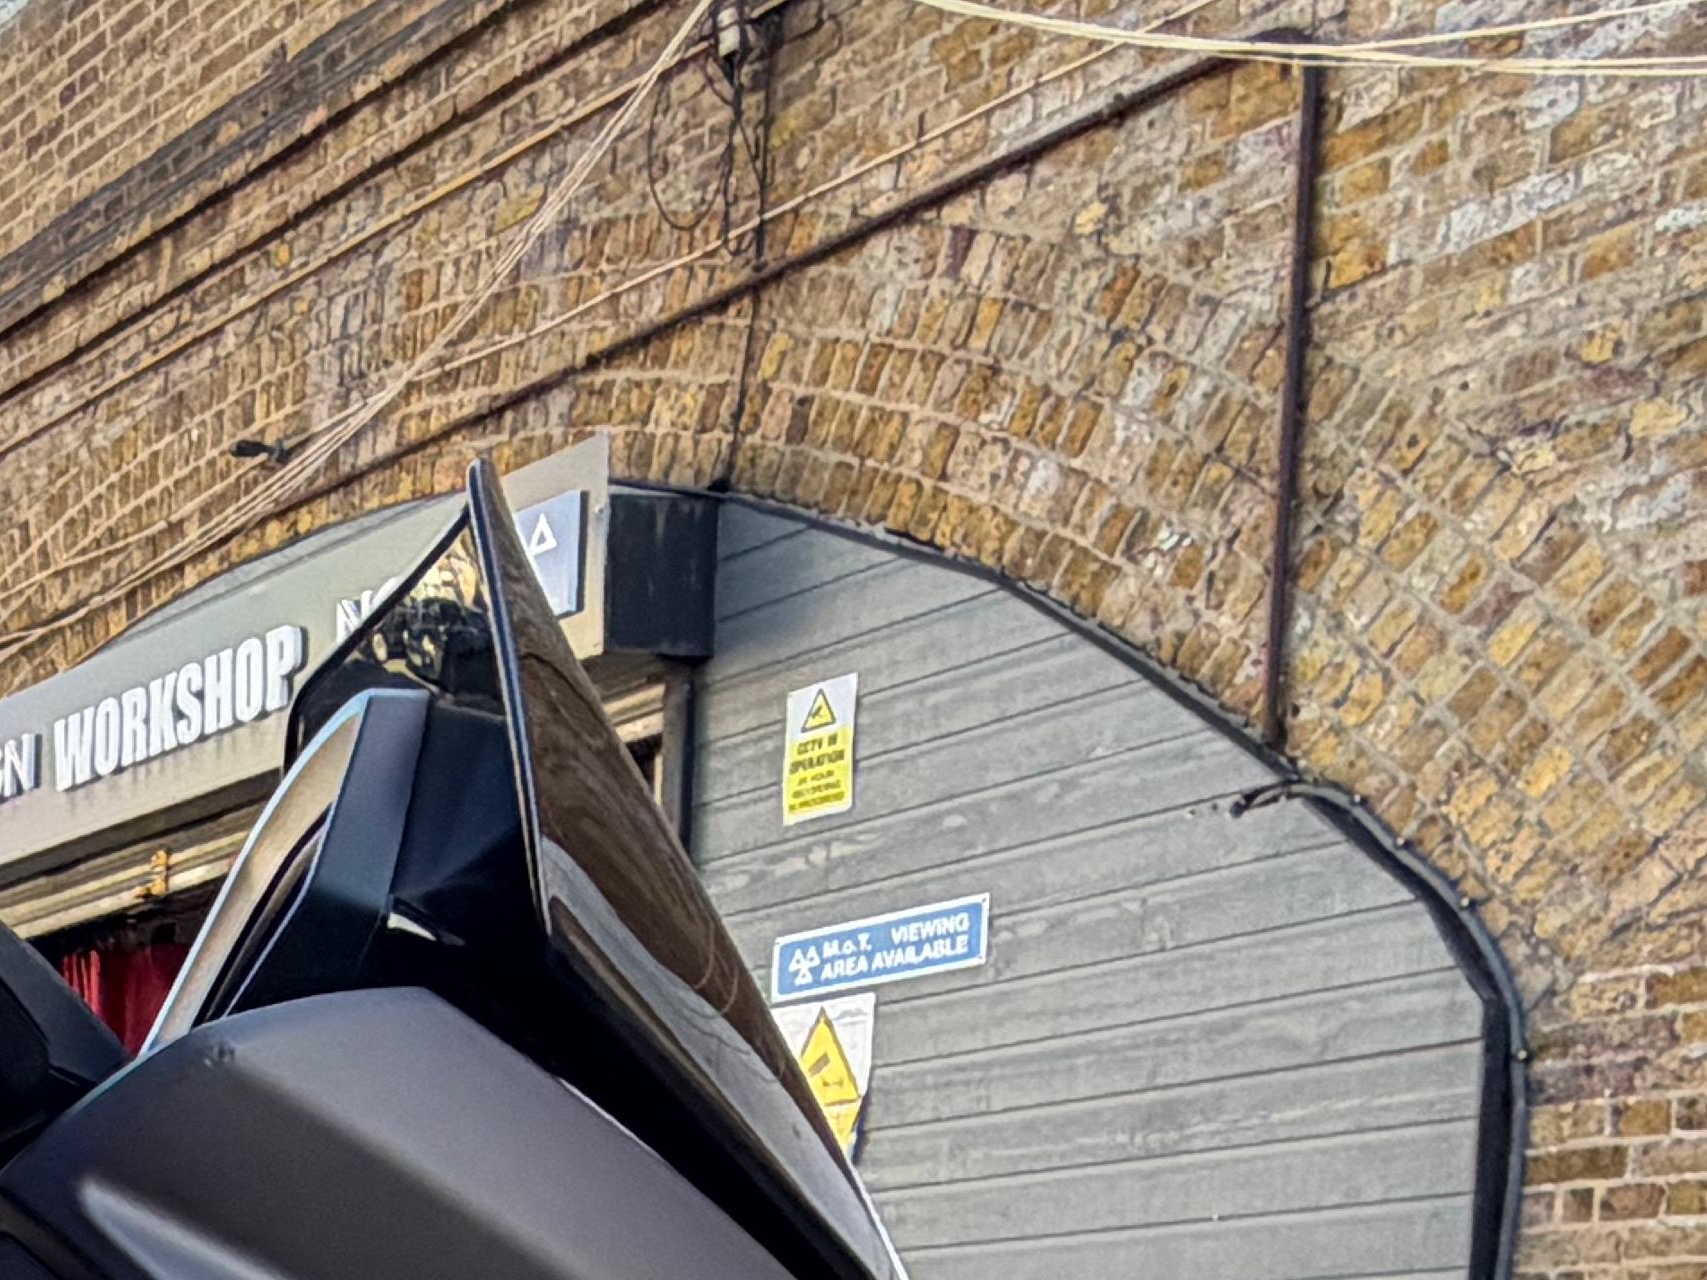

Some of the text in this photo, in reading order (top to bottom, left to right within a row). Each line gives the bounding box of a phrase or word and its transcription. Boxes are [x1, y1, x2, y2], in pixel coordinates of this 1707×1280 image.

[54, 624, 303, 792] WORKSHOP
[892, 913, 970, 945] VIEWING
[820, 935, 969, 981] AREA AVAILABLE
